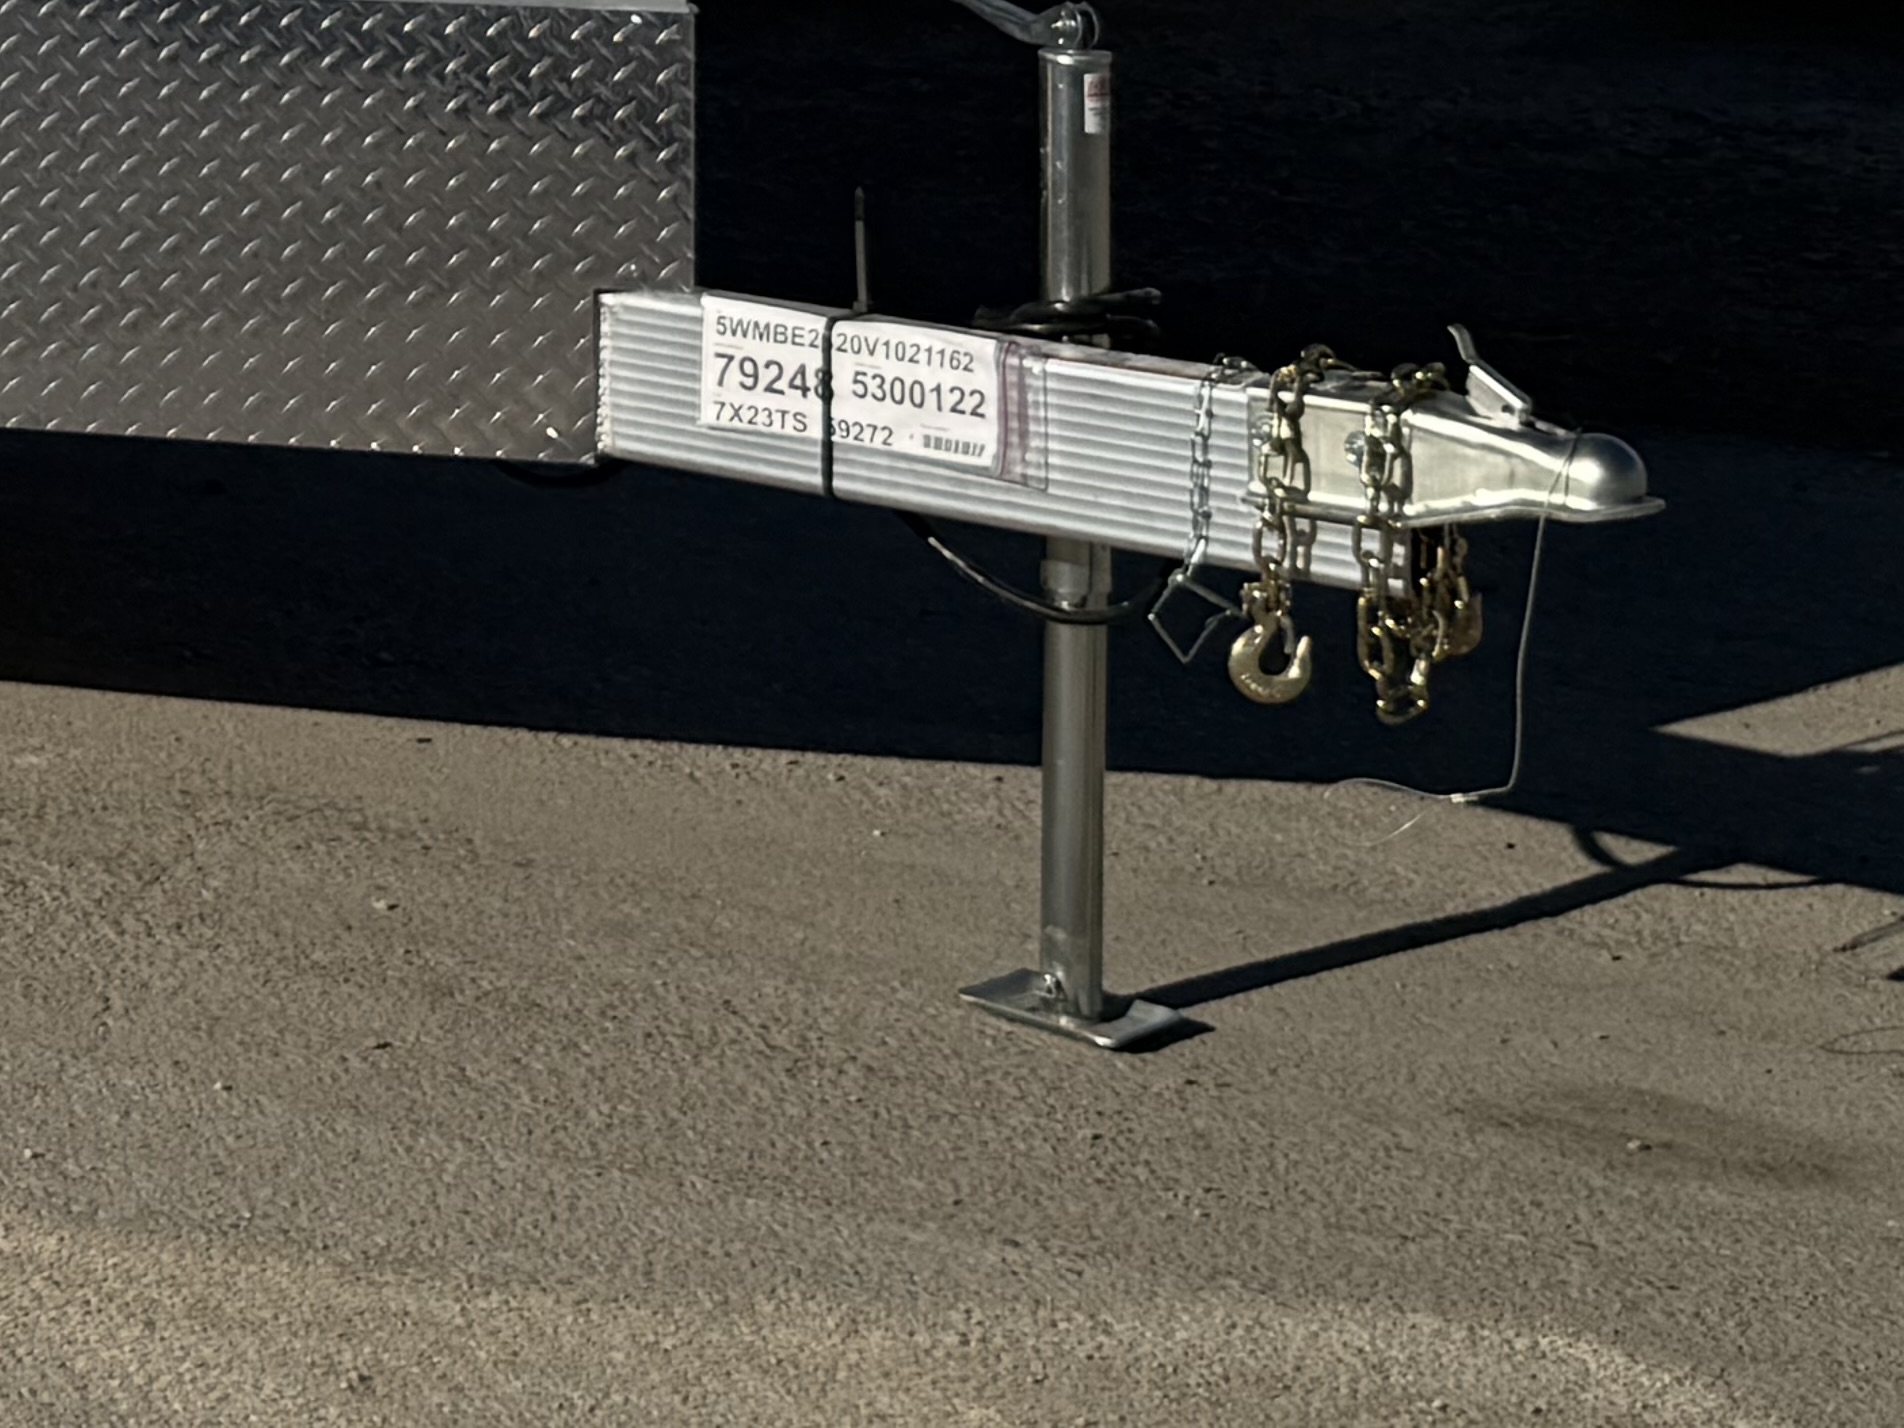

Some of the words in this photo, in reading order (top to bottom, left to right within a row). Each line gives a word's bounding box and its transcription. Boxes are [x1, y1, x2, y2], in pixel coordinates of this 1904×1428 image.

[715, 315, 975, 373] 5WMBE220V1021162
[713, 400, 808, 433] 7X23TS
[852, 370, 987, 420] 5300122
